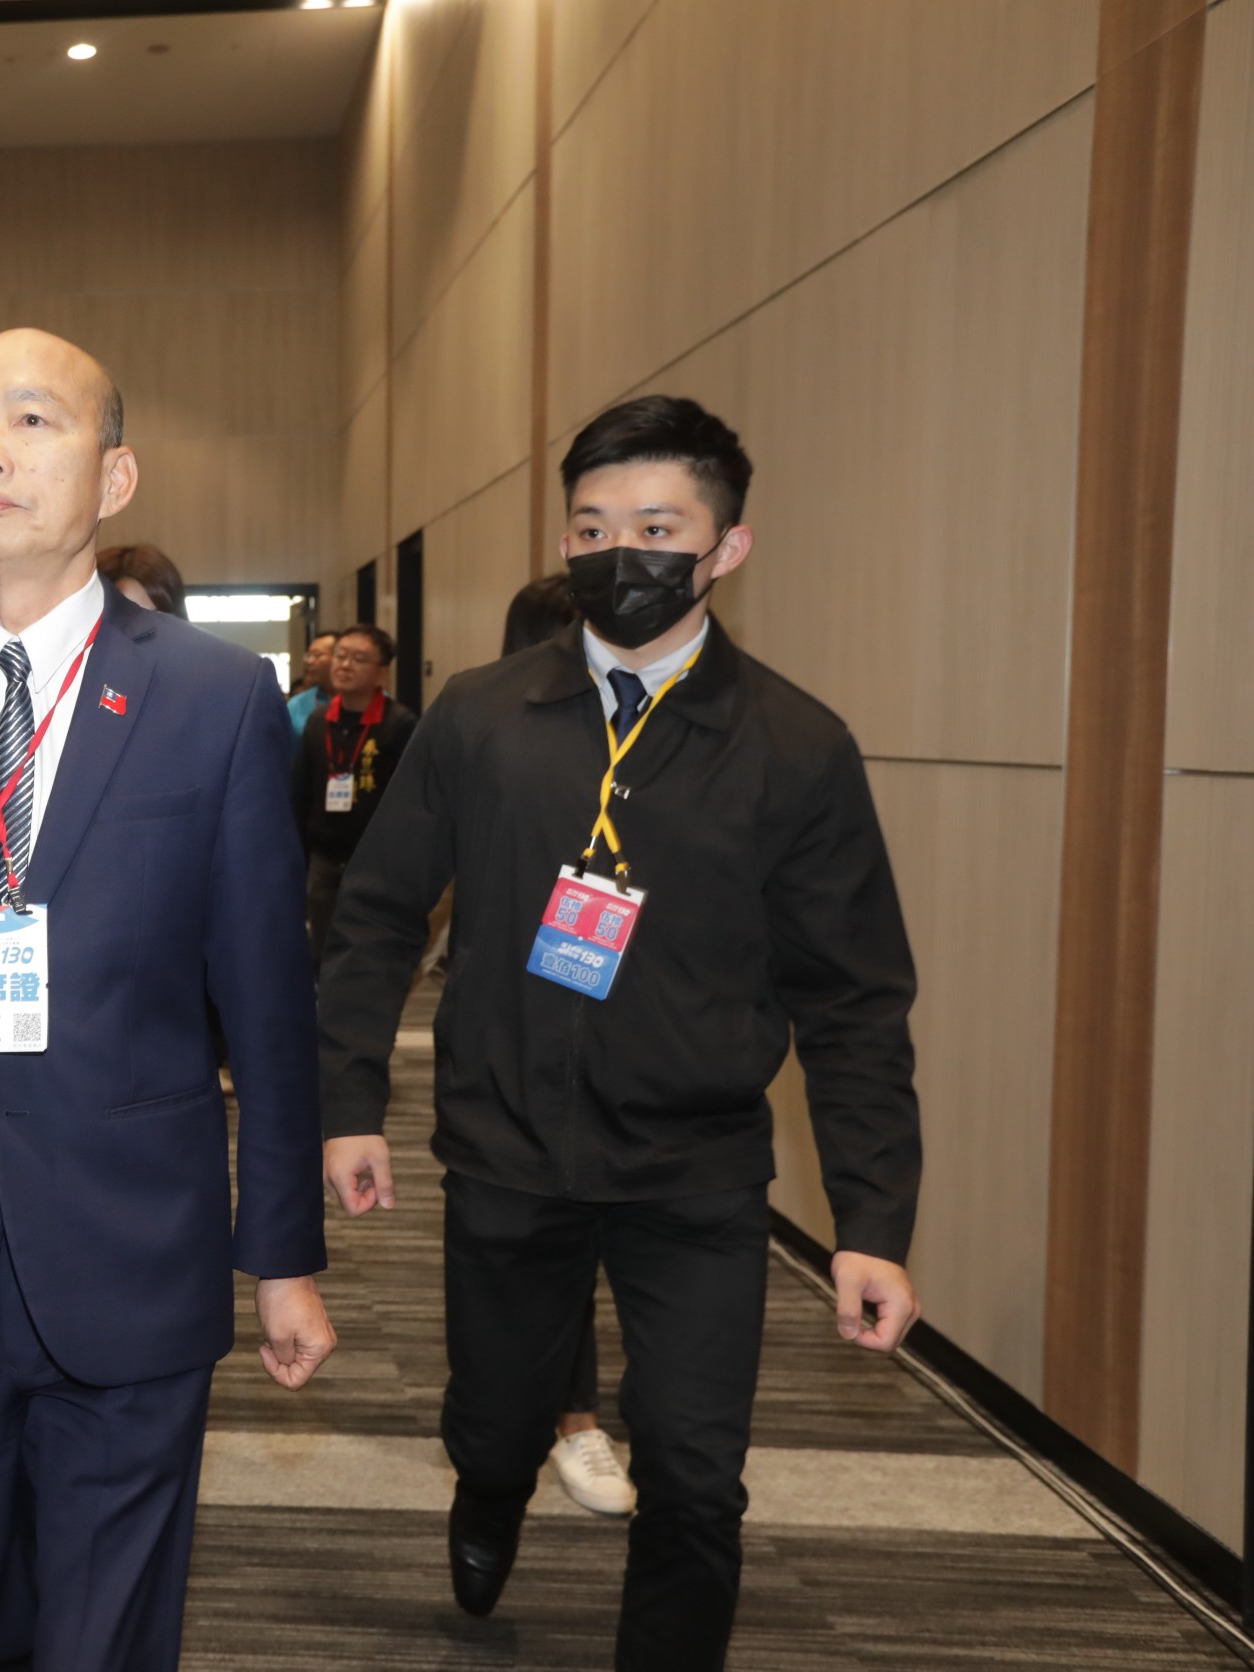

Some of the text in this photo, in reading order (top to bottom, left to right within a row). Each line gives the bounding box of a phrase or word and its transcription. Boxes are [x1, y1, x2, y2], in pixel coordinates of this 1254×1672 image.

[555, 907, 578, 926] 50
[595, 922, 618, 941] 50
[1, 946, 34, 964] 130
[580, 950, 604, 968] 130
